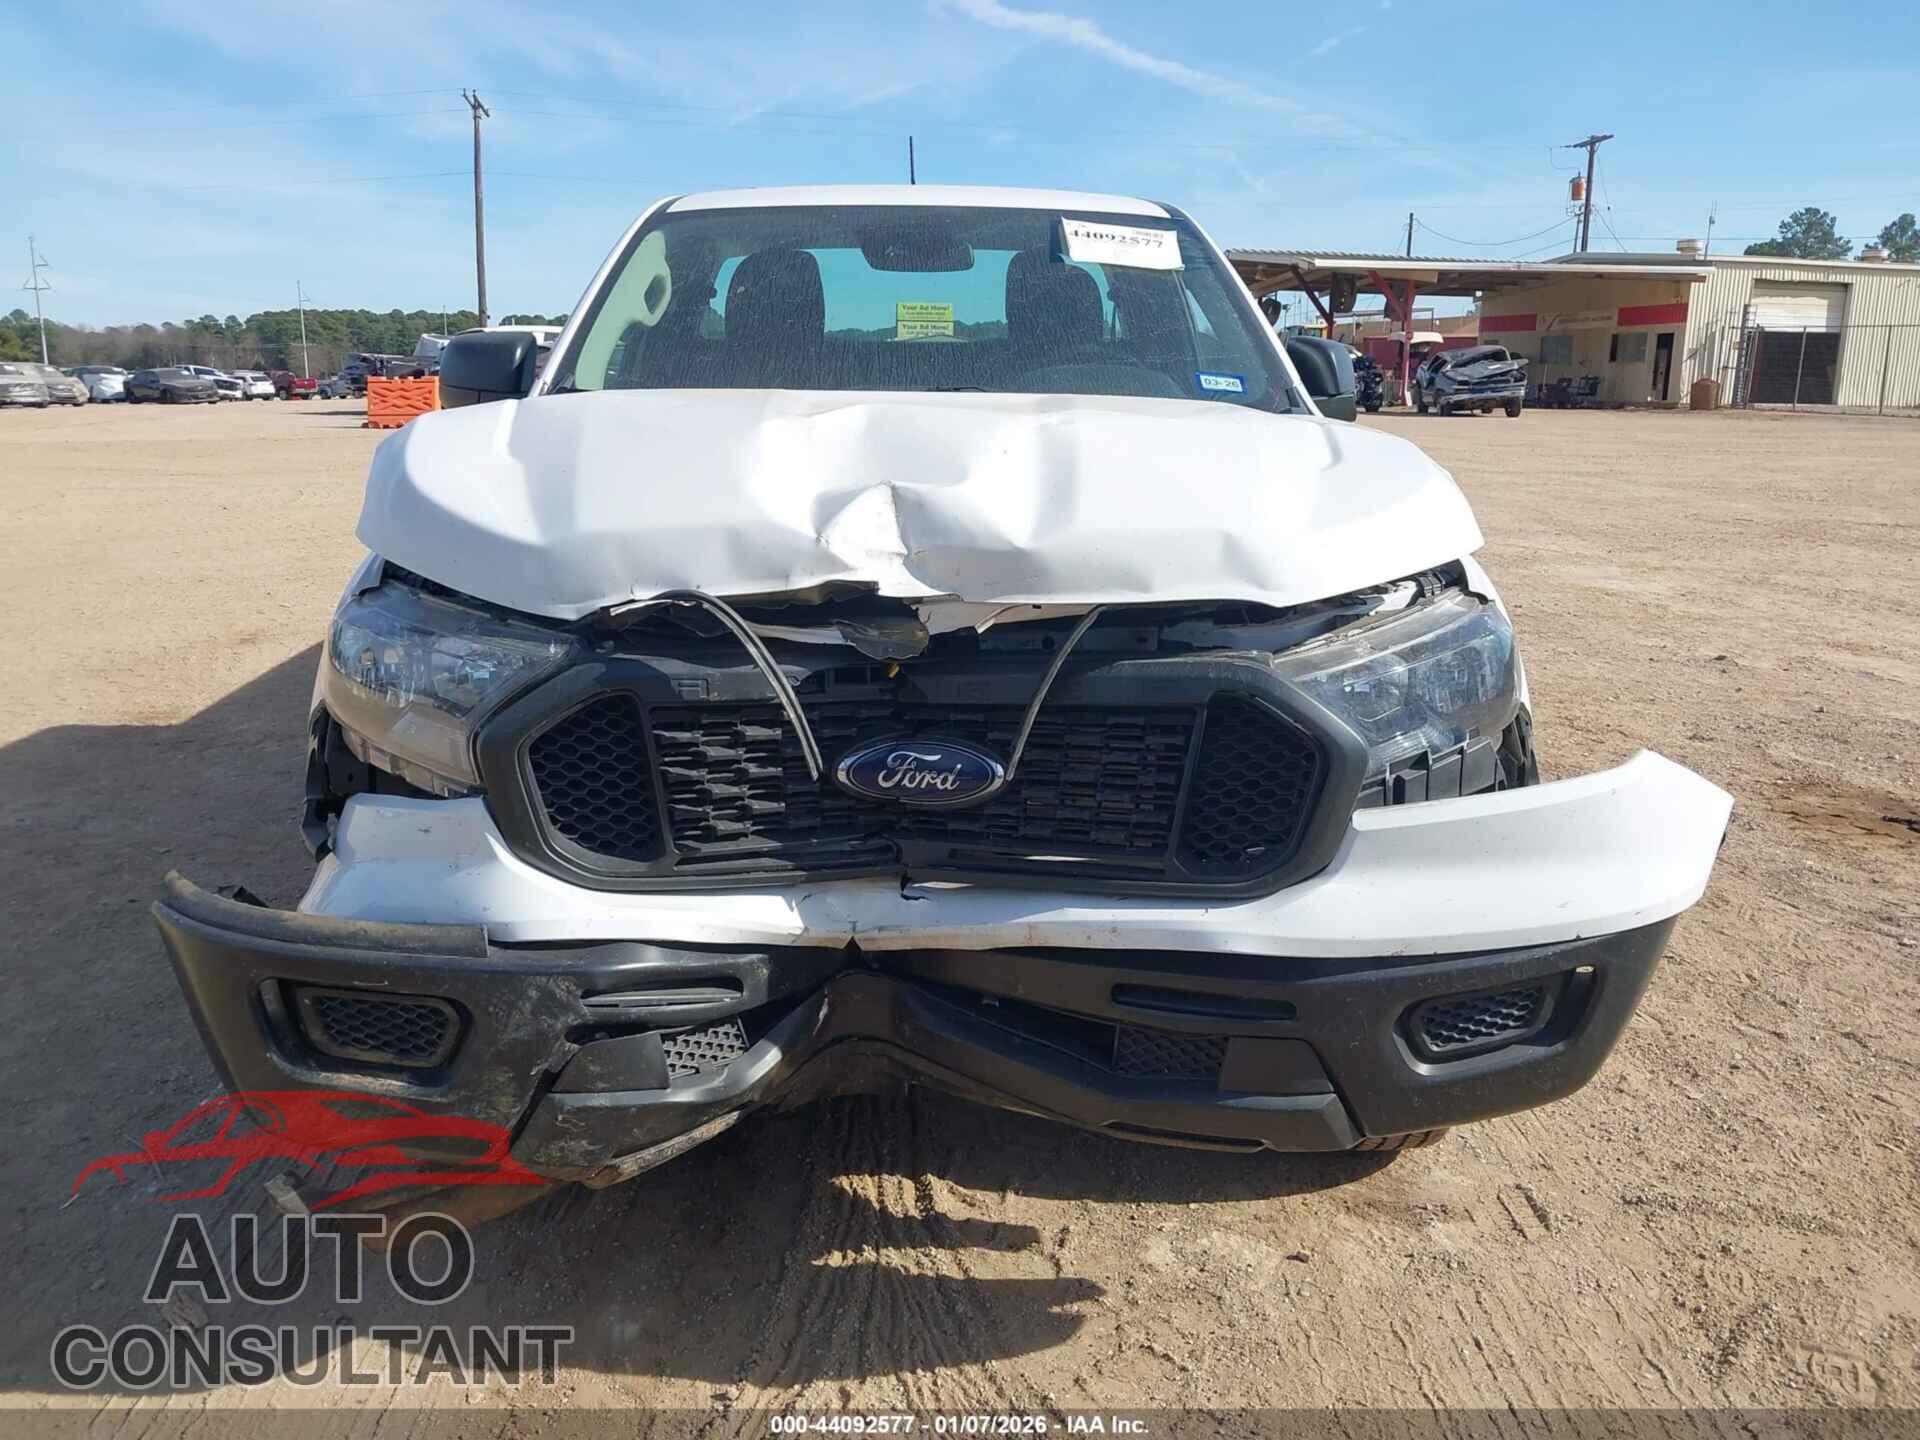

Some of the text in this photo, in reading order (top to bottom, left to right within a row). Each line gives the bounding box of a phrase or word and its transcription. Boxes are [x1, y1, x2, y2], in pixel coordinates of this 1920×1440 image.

[1069, 229, 1163, 248] 44092577
[1204, 378, 1240, 388] 03-26
[878, 751, 962, 791] Ford
